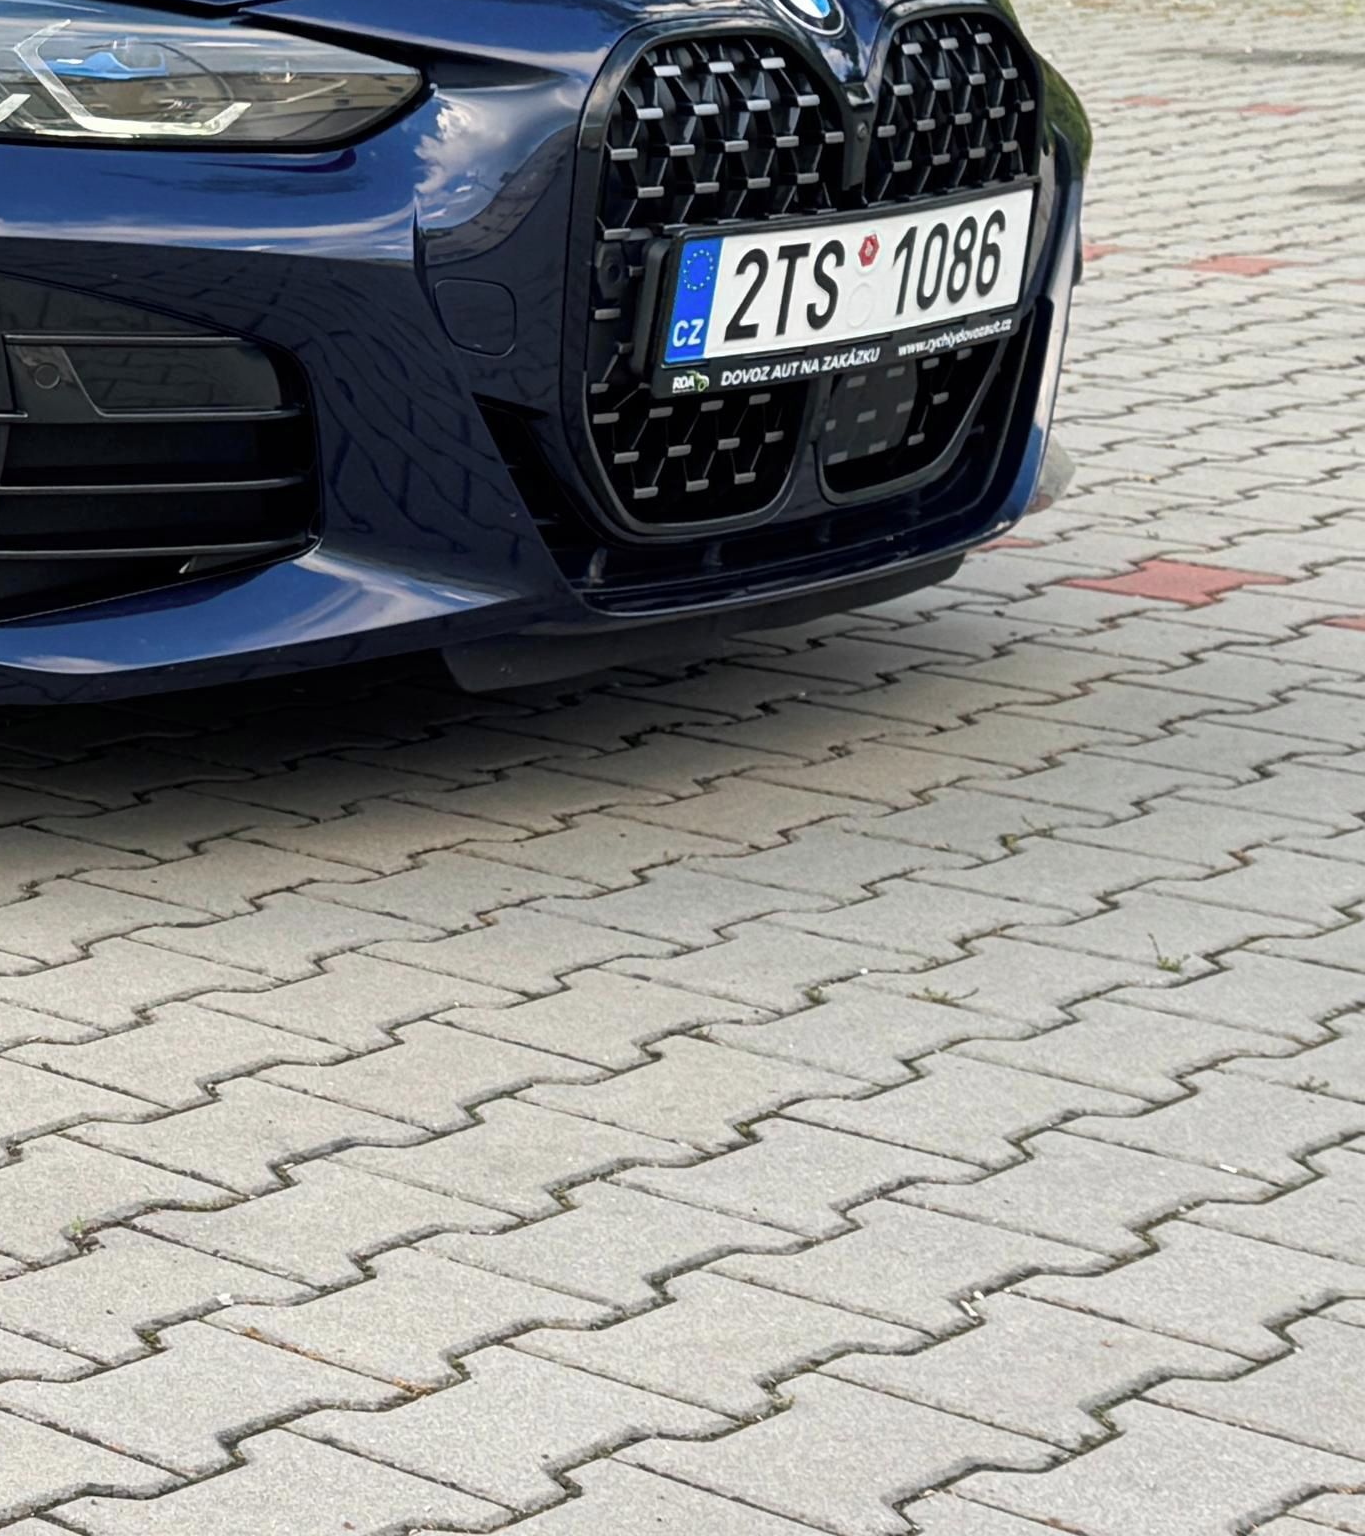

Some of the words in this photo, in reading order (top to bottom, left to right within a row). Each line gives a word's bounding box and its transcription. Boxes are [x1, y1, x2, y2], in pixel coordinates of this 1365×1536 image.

[724, 239, 846, 342] 2TS
[893, 209, 1006, 316] 1086
[672, 318, 704, 347] CZ
[721, 366, 771, 386] DOVOZ
[771, 362, 800, 379] AUT
[799, 358, 820, 374] NA
[821, 347, 881, 371] ZAKÁZKU
